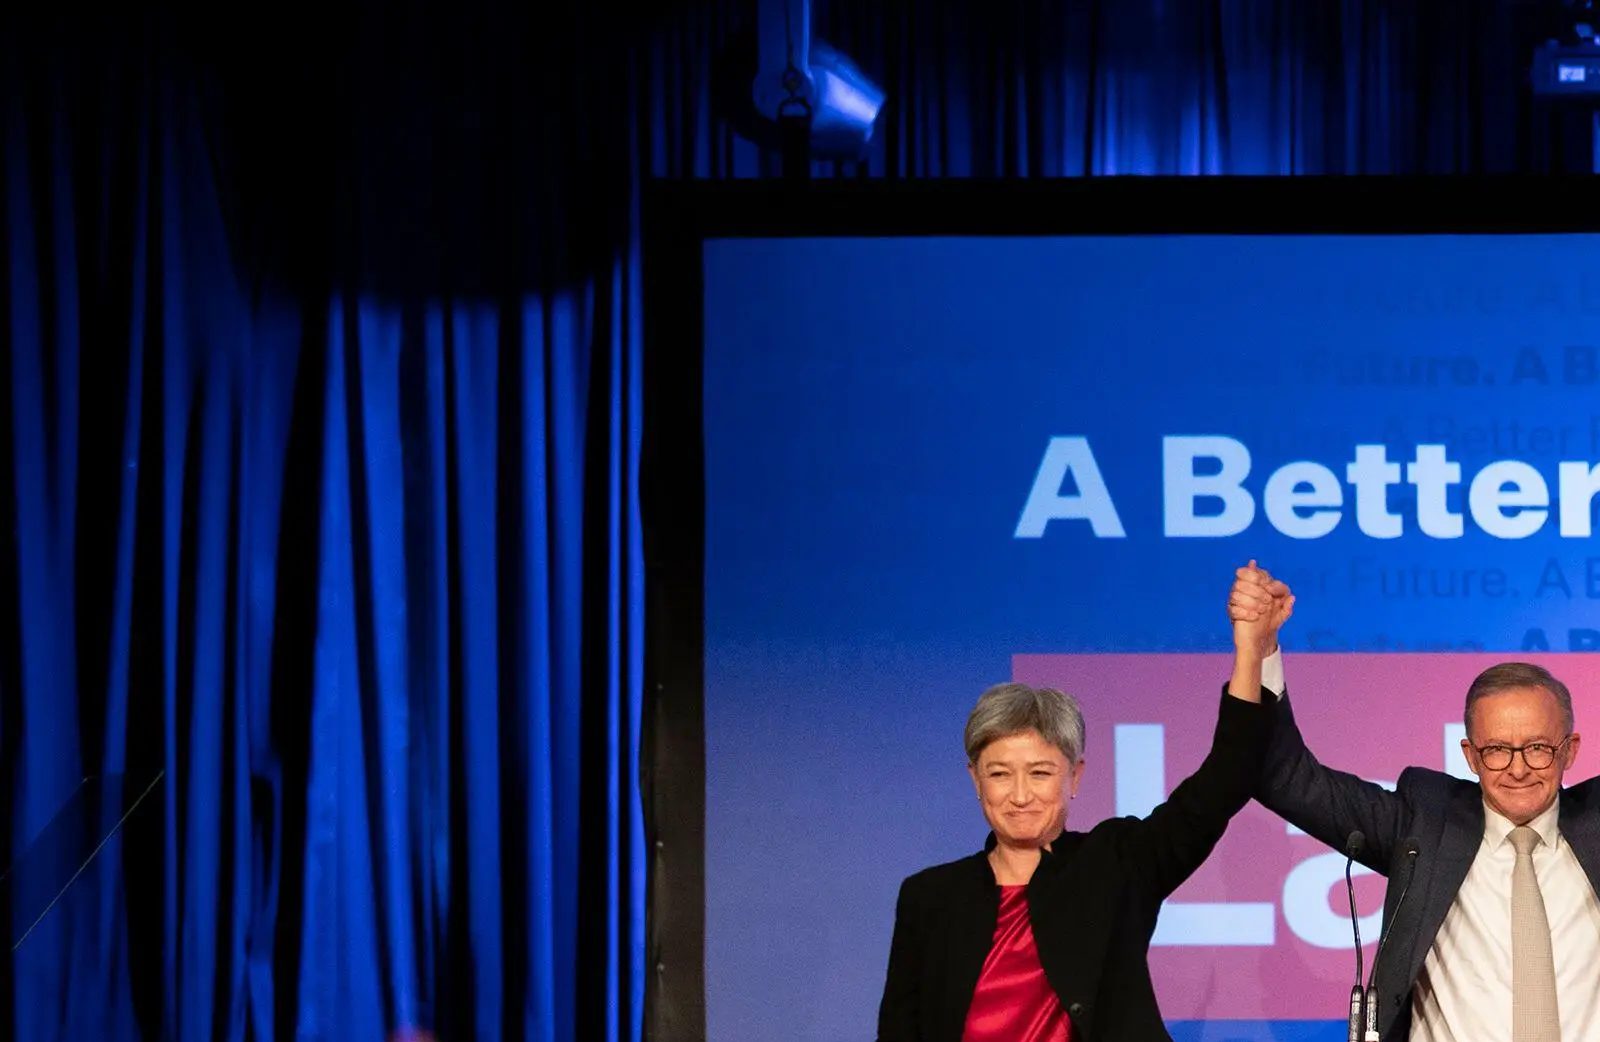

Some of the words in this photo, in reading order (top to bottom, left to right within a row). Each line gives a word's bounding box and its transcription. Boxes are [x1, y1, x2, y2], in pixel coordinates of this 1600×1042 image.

[1013, 436, 1127, 538] A
[1349, 556, 1520, 600] Future.
[1535, 556, 1572, 600] A
